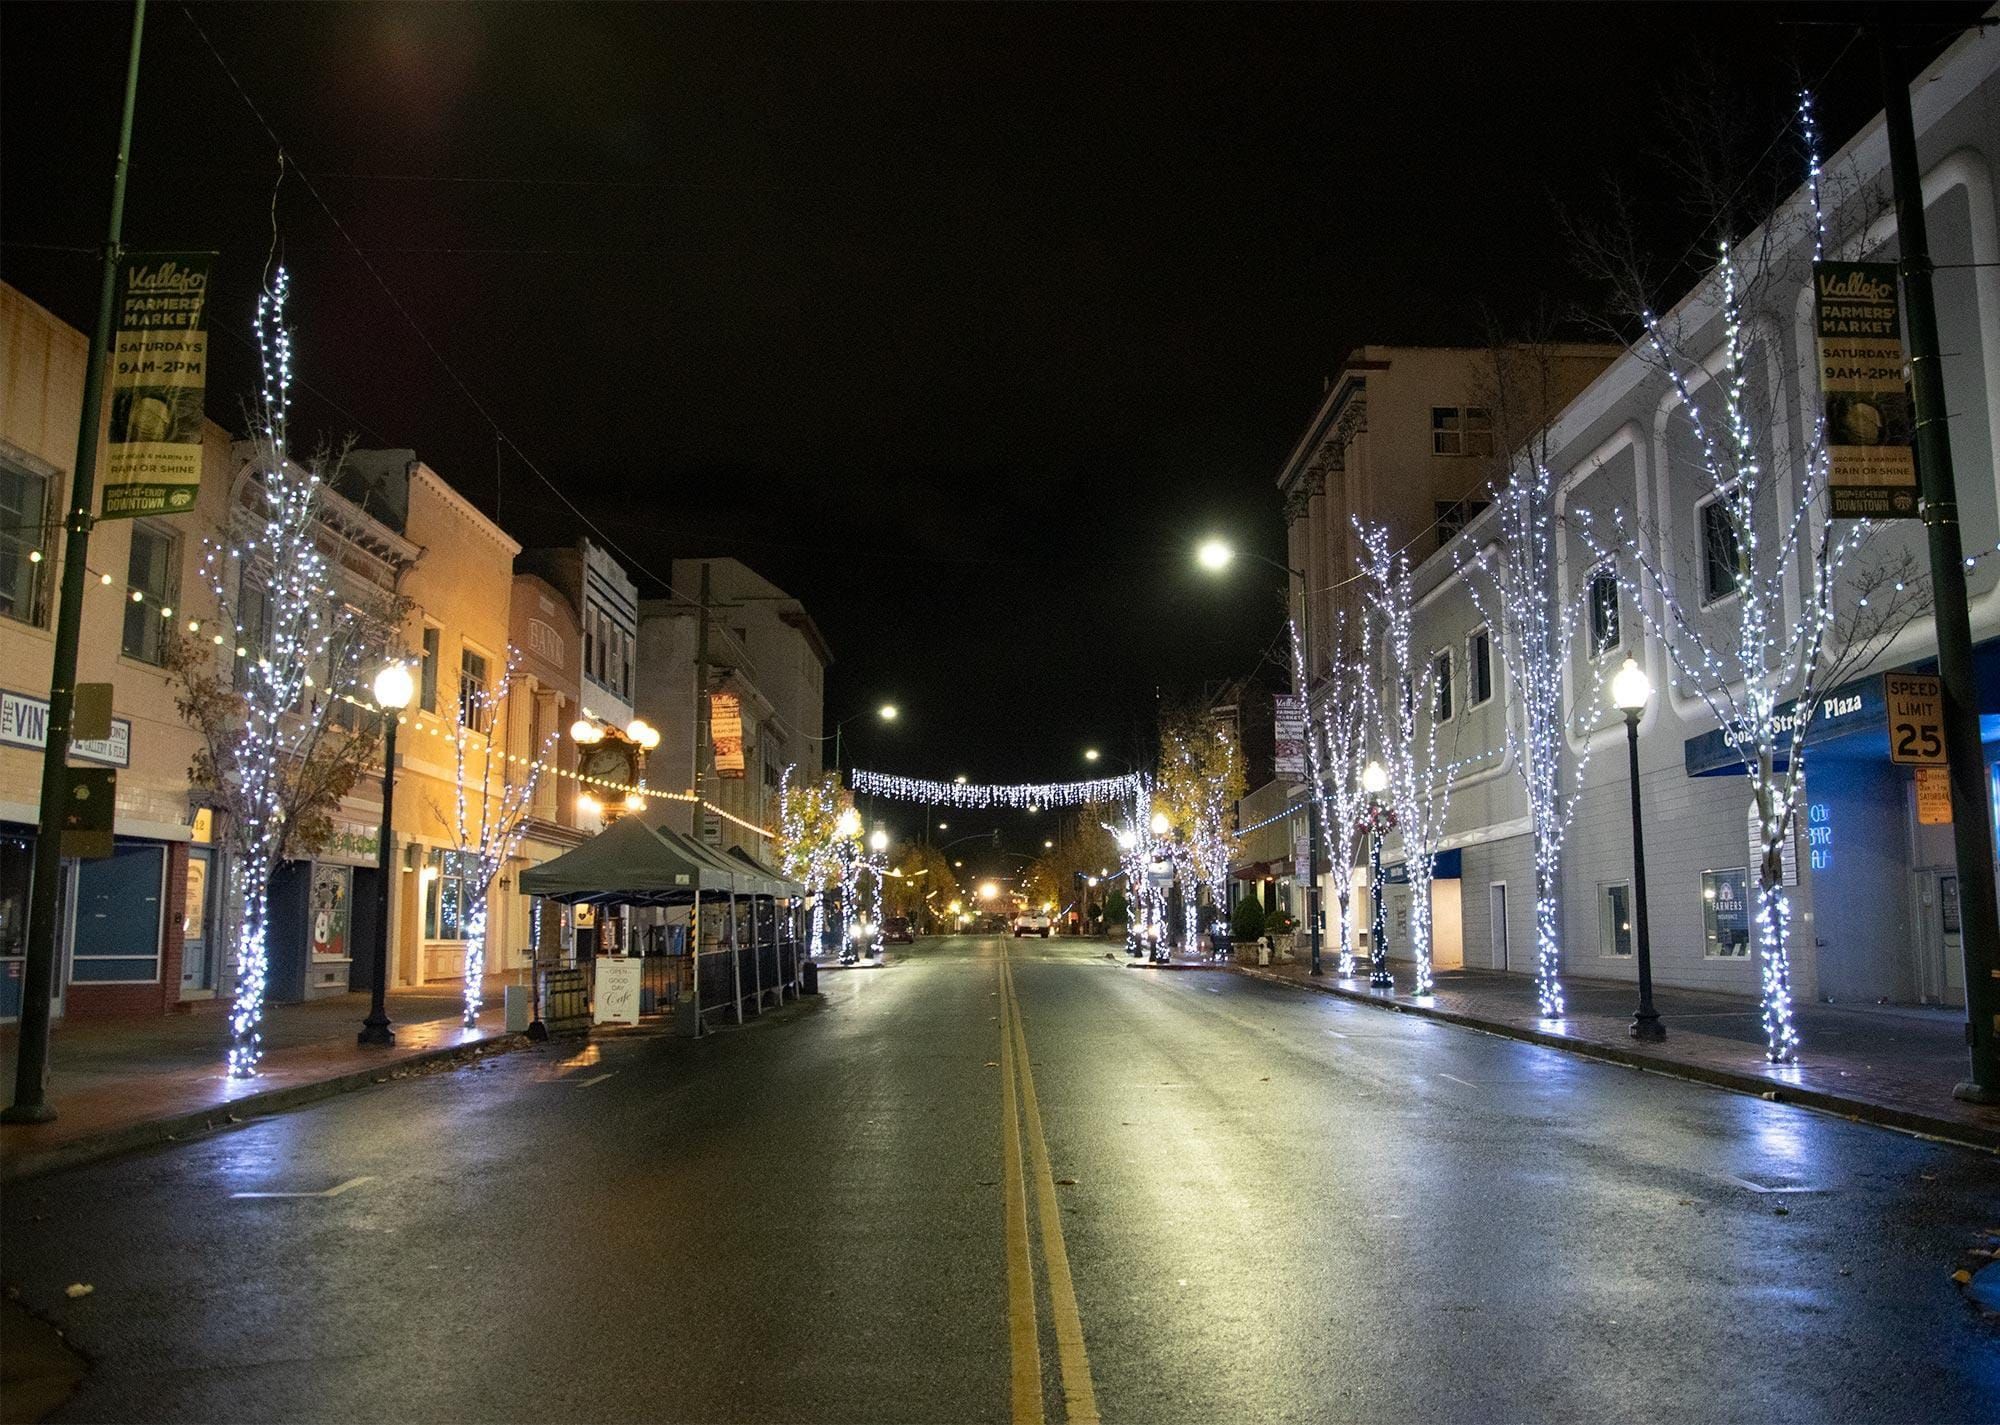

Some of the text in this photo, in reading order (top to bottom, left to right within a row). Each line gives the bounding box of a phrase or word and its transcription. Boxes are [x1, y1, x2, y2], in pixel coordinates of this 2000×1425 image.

[128, 262, 206, 294] Vallejo
[1820, 271, 1893, 304] Vallejo
[124, 313, 199, 326] MARKET
[1823, 320, 1892, 333] MARKET
[120, 342, 202, 352] SATURDAYS
[1823, 348, 1900, 359] SATURDAYS
[119, 361, 201, 374] 9AM-2PM
[1825, 367, 1901, 379] 9AM-2PM
[111, 463, 194, 474] RAIN OR SHINE
[1835, 467, 1909, 476] RAIN OR SHINE
[107, 498, 165, 512] DOWNTOWN
[1836, 500, 1889, 511] DOWNTOWN
[1891, 682, 1938, 697] SPEED
[1823, 695, 1862, 720] Plaza
[1898, 702, 1934, 716] LIMIT
[2, 700, 14, 734] THE
[1896, 724, 1941, 757] 25
[1712, 901, 1743, 912] FARMERS
